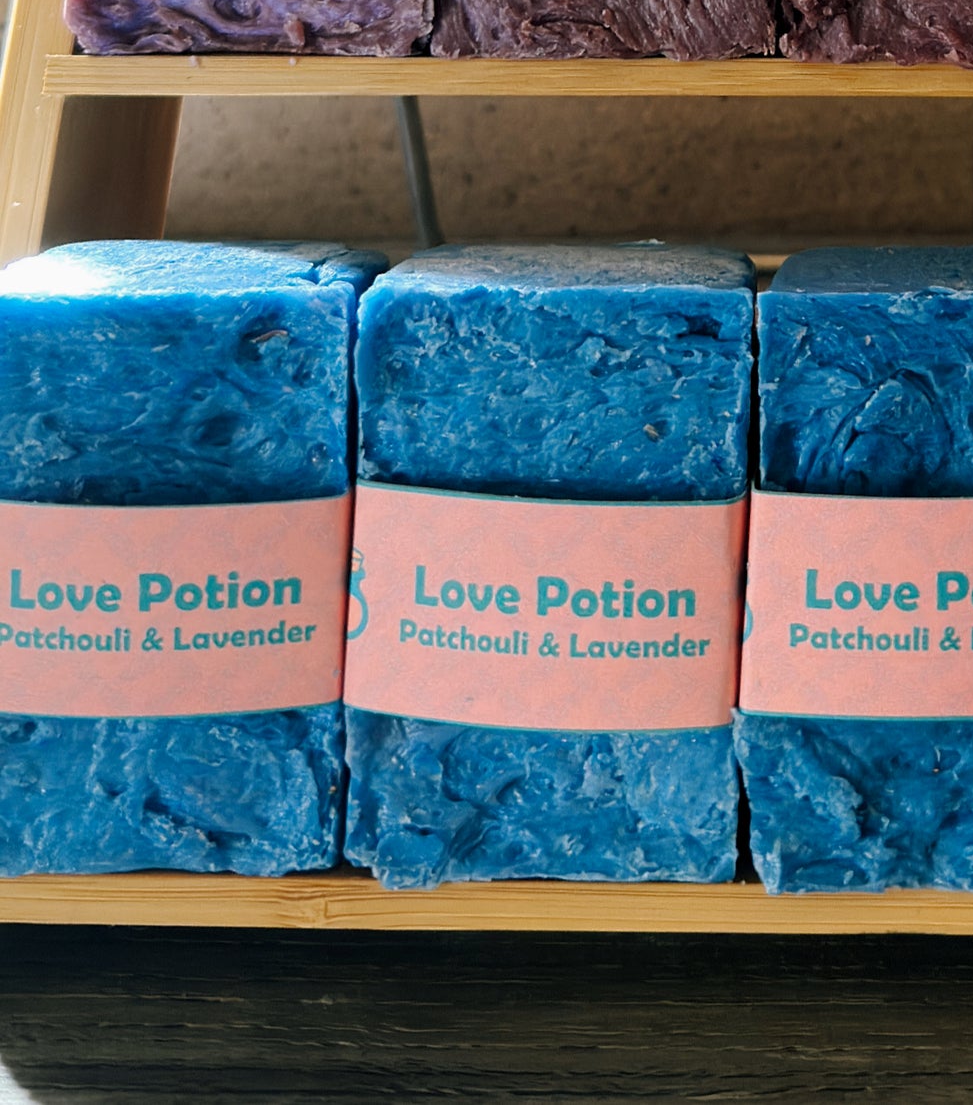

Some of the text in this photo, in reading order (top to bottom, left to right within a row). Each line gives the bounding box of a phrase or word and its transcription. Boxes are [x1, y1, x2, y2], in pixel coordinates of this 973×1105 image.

[8, 568, 302, 614] Love Potion
[413, 564, 697, 620] Love Potion
[804, 568, 921, 613] Love
[0, 620, 317, 653] Patchouli & Lavender
[398, 618, 711, 660] Patchouli & Lavender
[788, 622, 930, 652] Patchouli
[938, 626, 961, 653] &
